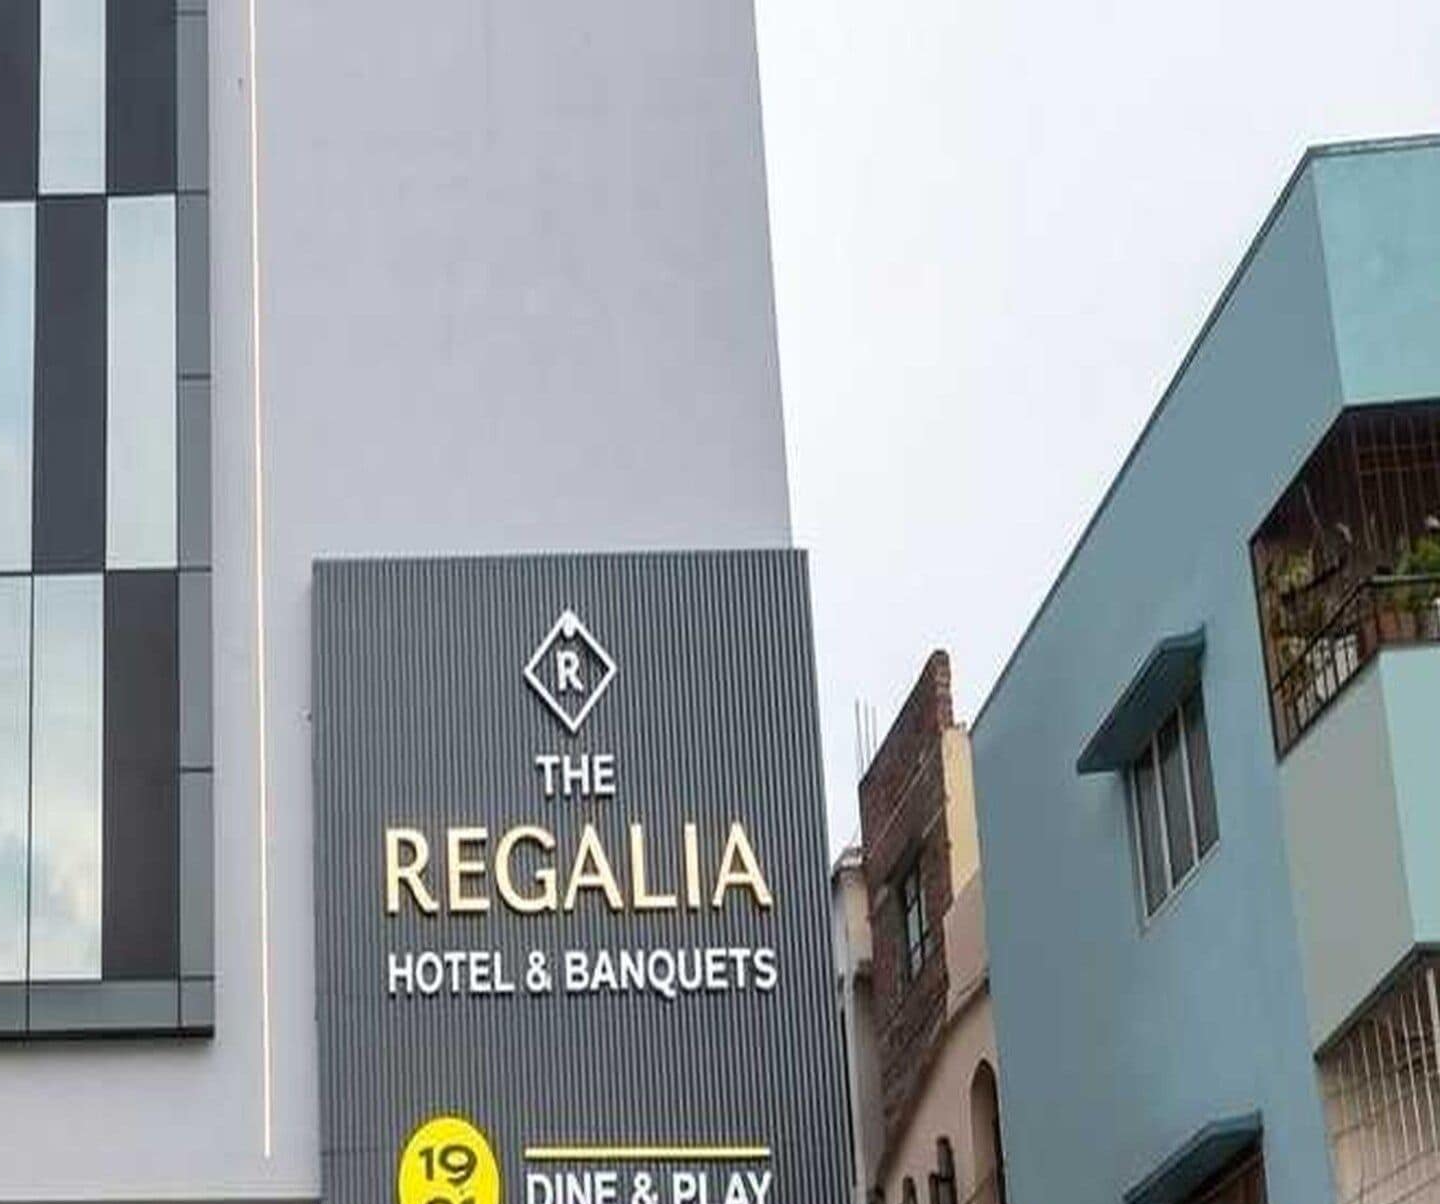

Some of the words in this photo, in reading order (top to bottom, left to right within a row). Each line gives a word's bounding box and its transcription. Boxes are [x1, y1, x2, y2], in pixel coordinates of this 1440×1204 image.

[556, 650, 584, 691] R
[536, 754, 617, 796] THE
[384, 820, 774, 915] REGALIA
[388, 951, 515, 994] HOTEL
[525, 950, 553, 992] &
[564, 947, 779, 998] BANQUETS
[418, 1144, 478, 1187] 19
